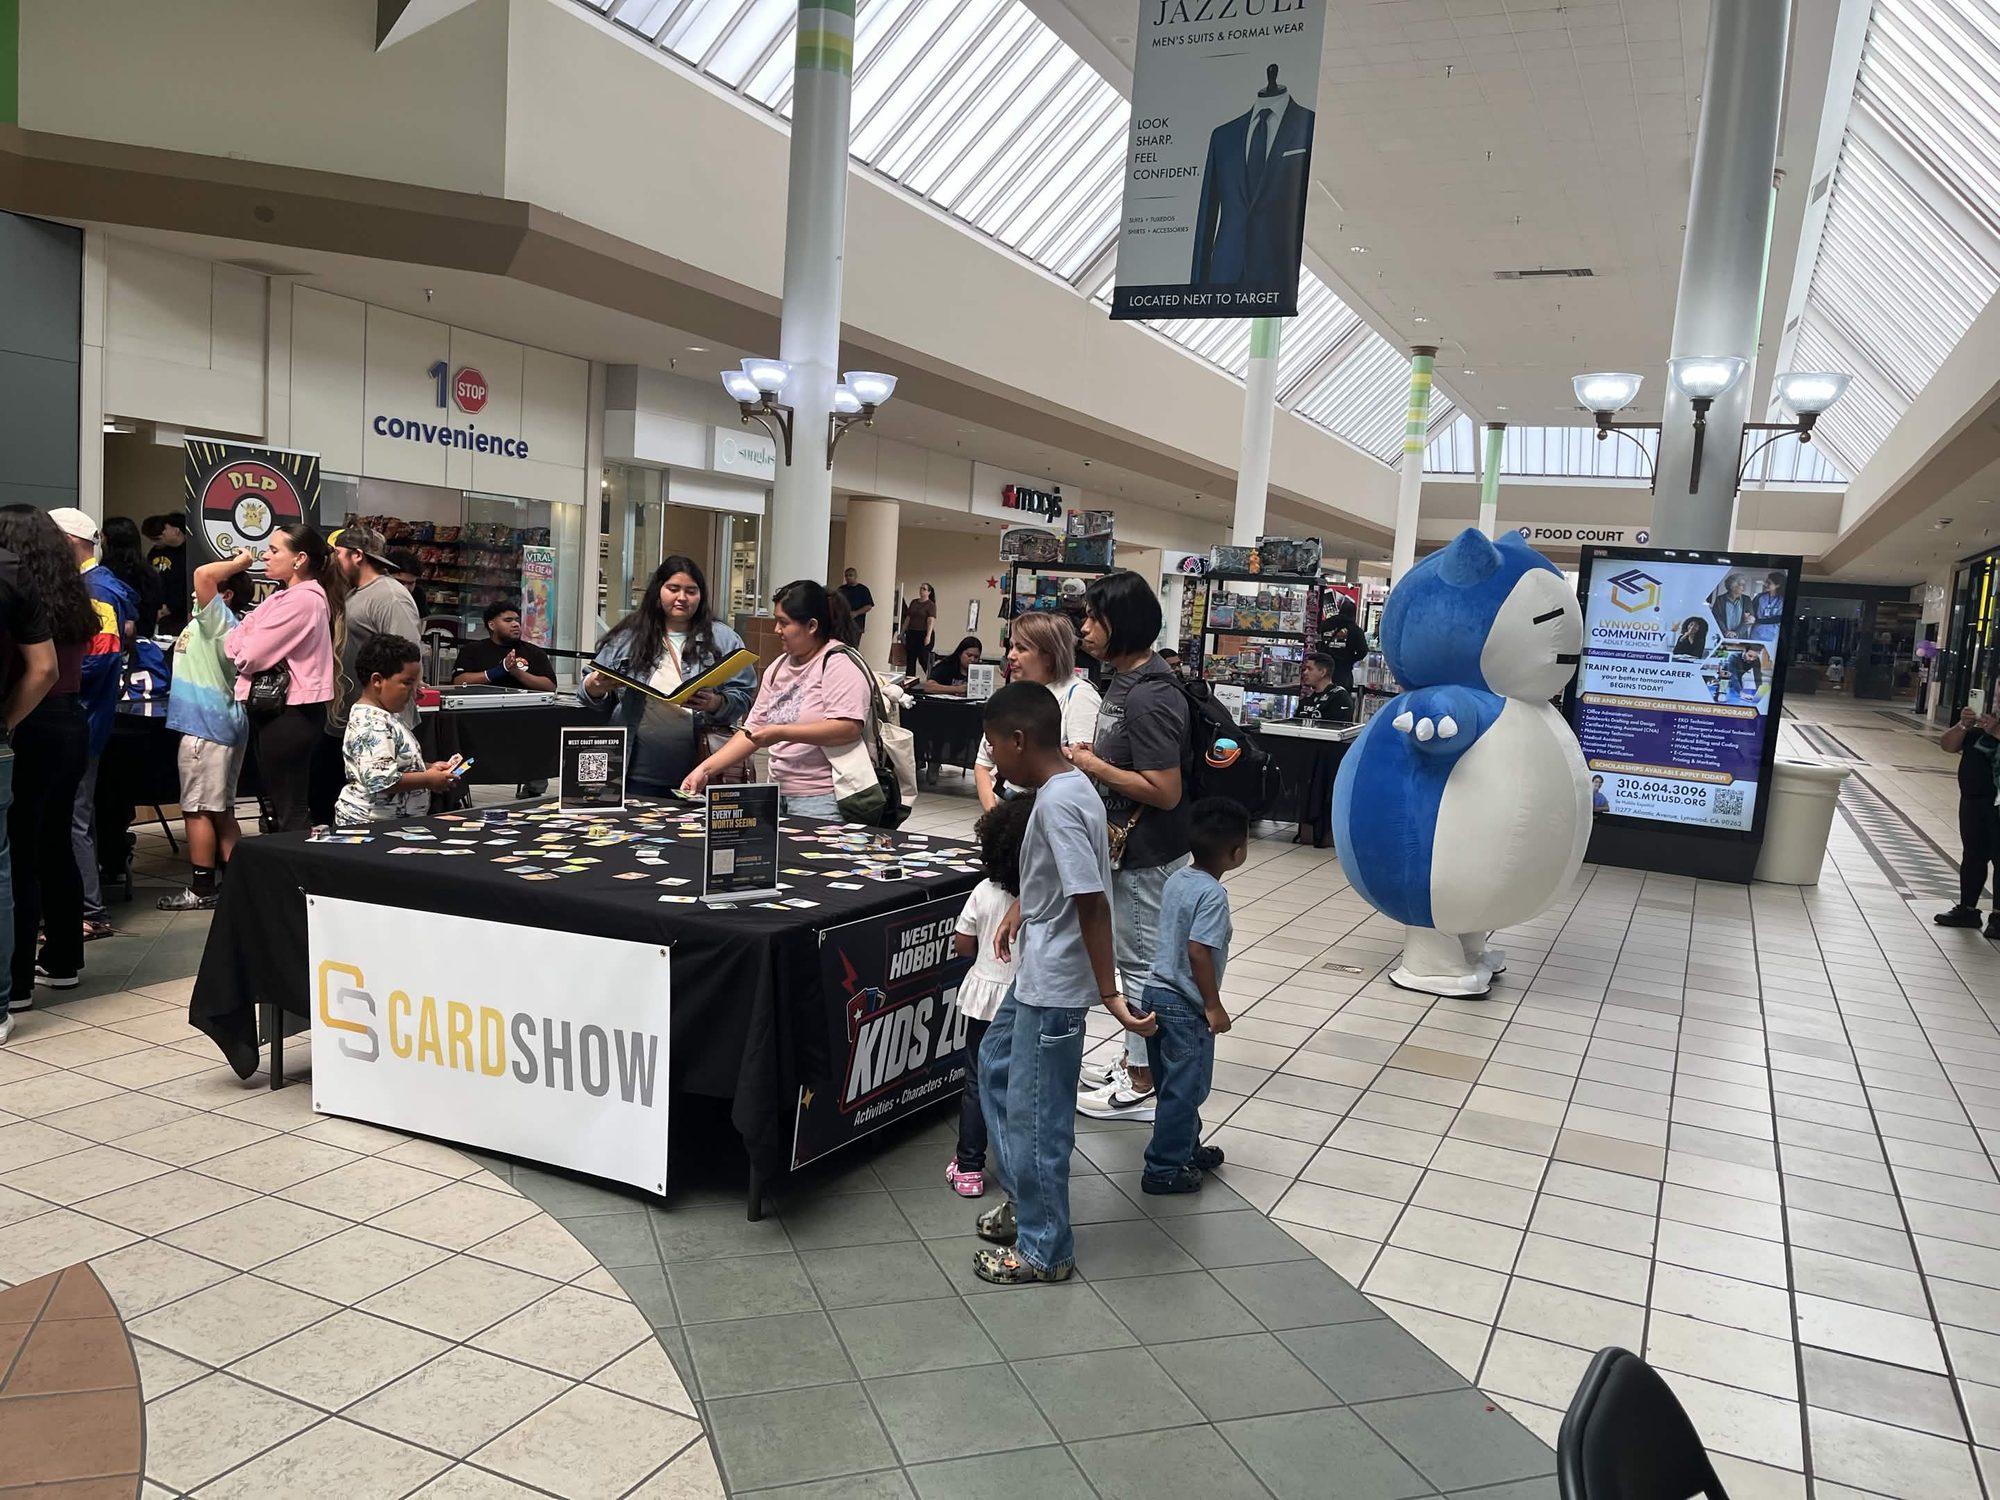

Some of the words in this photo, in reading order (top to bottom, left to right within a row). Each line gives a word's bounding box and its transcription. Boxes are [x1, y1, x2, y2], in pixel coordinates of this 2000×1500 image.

[1152, 35, 1184, 48] MEN'S
[1188, 33, 1214, 45] SUITS
[1218, 31, 1225, 41] &
[1228, 26, 1270, 40] FORMAL
[1273, 22, 1304, 34] WEAR
[1137, 117, 1169, 129] LOOK
[1136, 134, 1173, 146] SHARP.
[1135, 152, 1157, 163] FEEL
[1133, 166, 1200, 180] CONFIDENT.
[1152, 226, 1189, 234] ACCESSORIES
[1129, 294, 1180, 307] LOCATED
[1183, 293, 1212, 305] NEXT
[1215, 293, 1232, 304] TO
[1235, 292, 1280, 304] TARGET
[428, 361, 448, 408] 1
[458, 382, 485, 400] STOP
[374, 415, 529, 459] convenience
[739, 448, 775, 465] sunglas
[227, 472, 278, 491] DLP
[1535, 528, 1572, 540] FOOD
[1576, 530, 1624, 542] COURT
[1599, 619, 1660, 631] LYNWOOD
[1592, 628, 1666, 642] COMMUNITY
[1588, 649, 1615, 657] Education
[1585, 663, 1609, 672] TRAIN
[1611, 665, 1627, 673] FOR
[1619, 674, 1638, 682] better
[1640, 677, 1674, 685] tomorrow
[1610, 682, 1636, 690] BEGINS
[1638, 683, 1664, 692] TODAY!
[1617, 698, 1633, 706] LOW
[1652, 701, 1677, 710] CAREER
[1678, 704, 1711, 713] TRAINING
[1713, 707, 1753, 717] PROGRAMS
[1605, 723, 1623, 731] Nursing
[1721, 741, 1739, 749] Coding
[1696, 759, 1720, 767] Marketing
[1595, 761, 1643, 772] SCHOLARSHIPS
[1644, 766, 1678, 777] AVAILABLE
[1679, 770, 1699, 779] APPLY
[1701, 772, 1727, 782] TODAY!
[1617, 778, 1707, 798] 310.604.3096
[1616, 789, 1706, 807] LCAS.MYLUSD.ORG
[712, 809, 731, 819] EVERY
[733, 809, 743, 818] HIT
[712, 819, 734, 830] WORTH
[735, 818, 757, 828] SEEING
[1721, 819, 1742, 828] 90262
[901, 924, 934, 949] WEST
[890, 939, 944, 980] HOBBY
[388, 990, 658, 1108] CARDSHOW
[846, 996, 934, 1104] KIDS
[935, 987, 968, 1059] ZO
[854, 1098, 894, 1127] Activities
[901, 1076, 943, 1104] Characters
